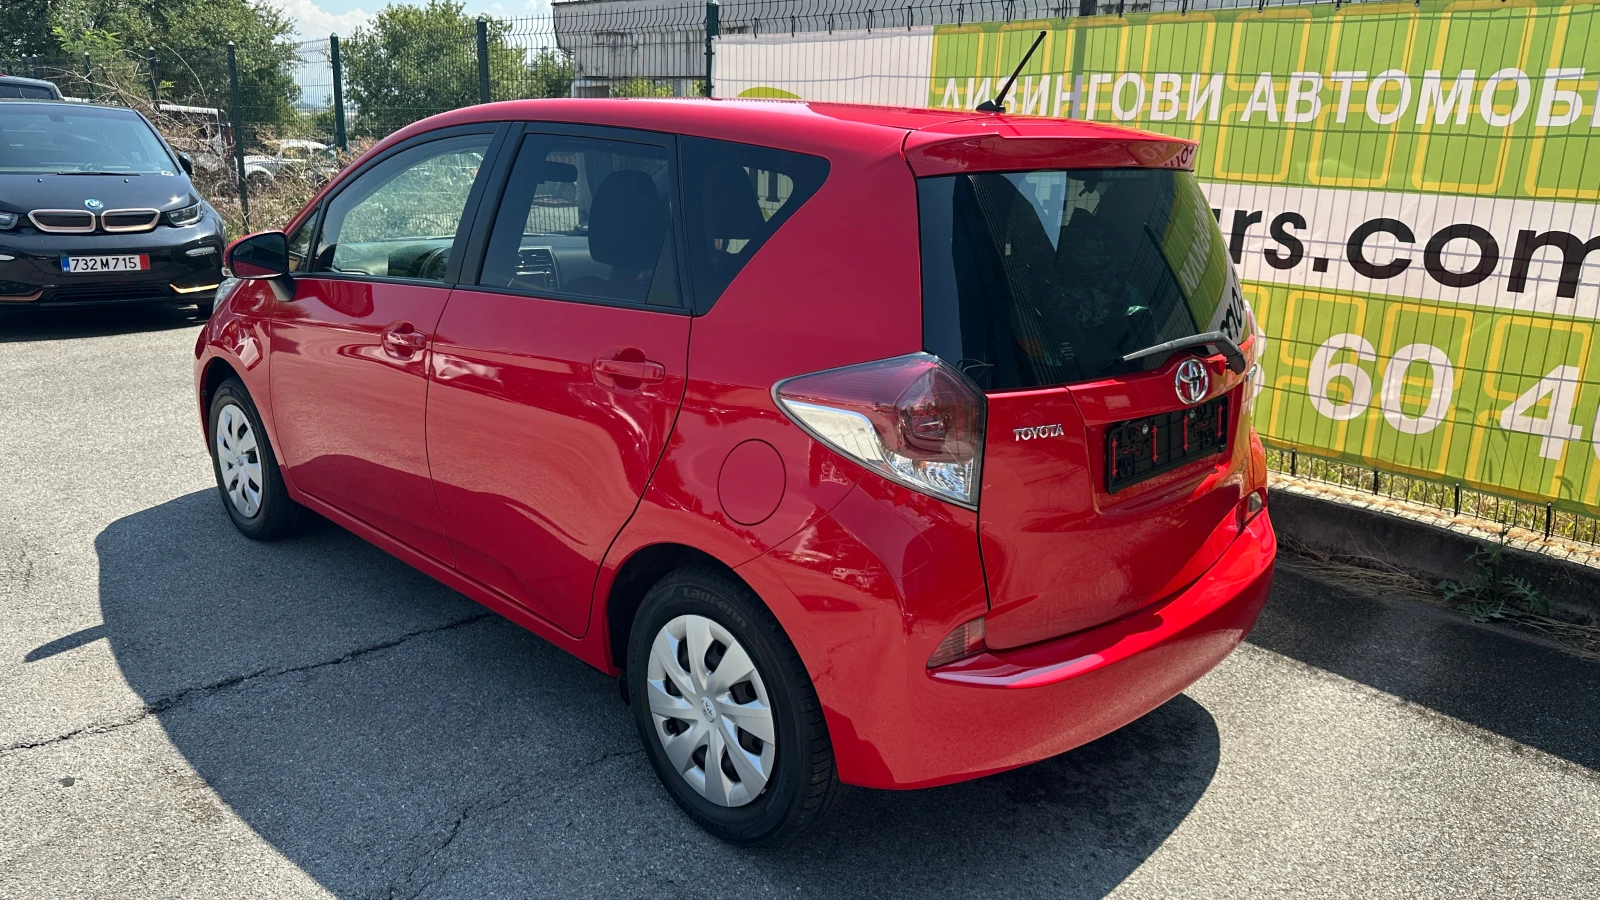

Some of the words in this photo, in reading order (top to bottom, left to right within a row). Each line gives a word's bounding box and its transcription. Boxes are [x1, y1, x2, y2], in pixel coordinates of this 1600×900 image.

[1240, 66, 1600, 127] АВТОМОБ
[71, 257, 137, 271] 732M715
[1212, 206, 1600, 299] rs.com
[1307, 332, 1454, 435] 60
[1500, 365, 1600, 460] 4
[1013, 423, 1064, 442] TOYOTA
